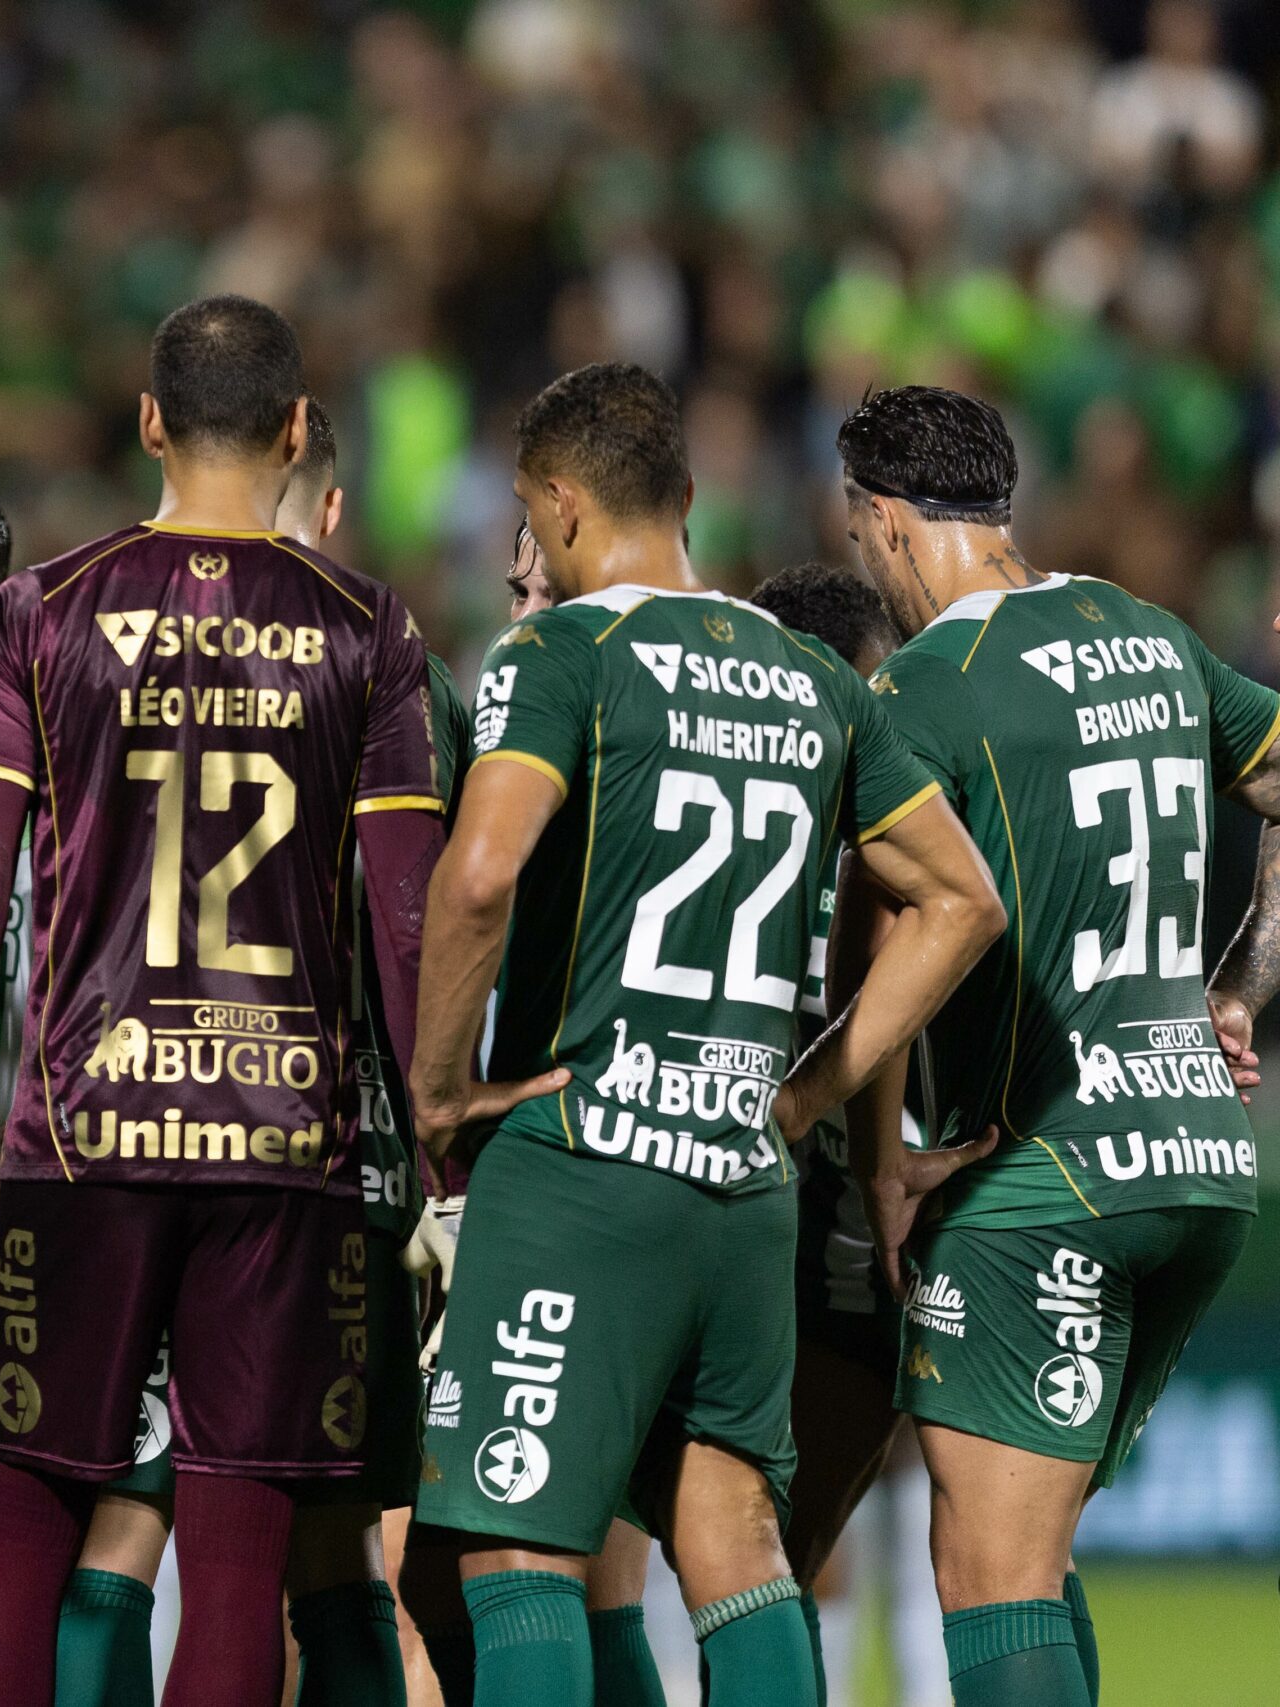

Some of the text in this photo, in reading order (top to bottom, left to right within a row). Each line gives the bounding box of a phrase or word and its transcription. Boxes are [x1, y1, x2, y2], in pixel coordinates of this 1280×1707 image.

[153, 614, 326, 666] SICOOB
[1073, 636, 1184, 682] SICOOB
[120, 676, 304, 729] LÉO VIEIRA
[685, 652, 819, 707] SICOOB
[667, 709, 824, 770] H.MERITÃO
[1075, 691, 1200, 746] BRUNO L.
[125, 749, 297, 977] 12
[621, 768, 814, 1013] 22
[1068, 756, 1206, 993] 33
[192, 1005, 279, 1033] GRUPO
[1147, 1023, 1204, 1050] GRUPO
[151, 1037, 319, 1090] BUGIO
[698, 1042, 774, 1077] GRUPO
[1124, 1053, 1236, 1099] BUGIO
[74, 1107, 324, 1168] Unimed
[1095, 1125, 1258, 1181] Unime
[327, 1232, 368, 1364] alfa
[1035, 1246, 1104, 1353] alfa
[931, 1316, 965, 1338] MALTE
[491, 1288, 576, 1427] alfa
